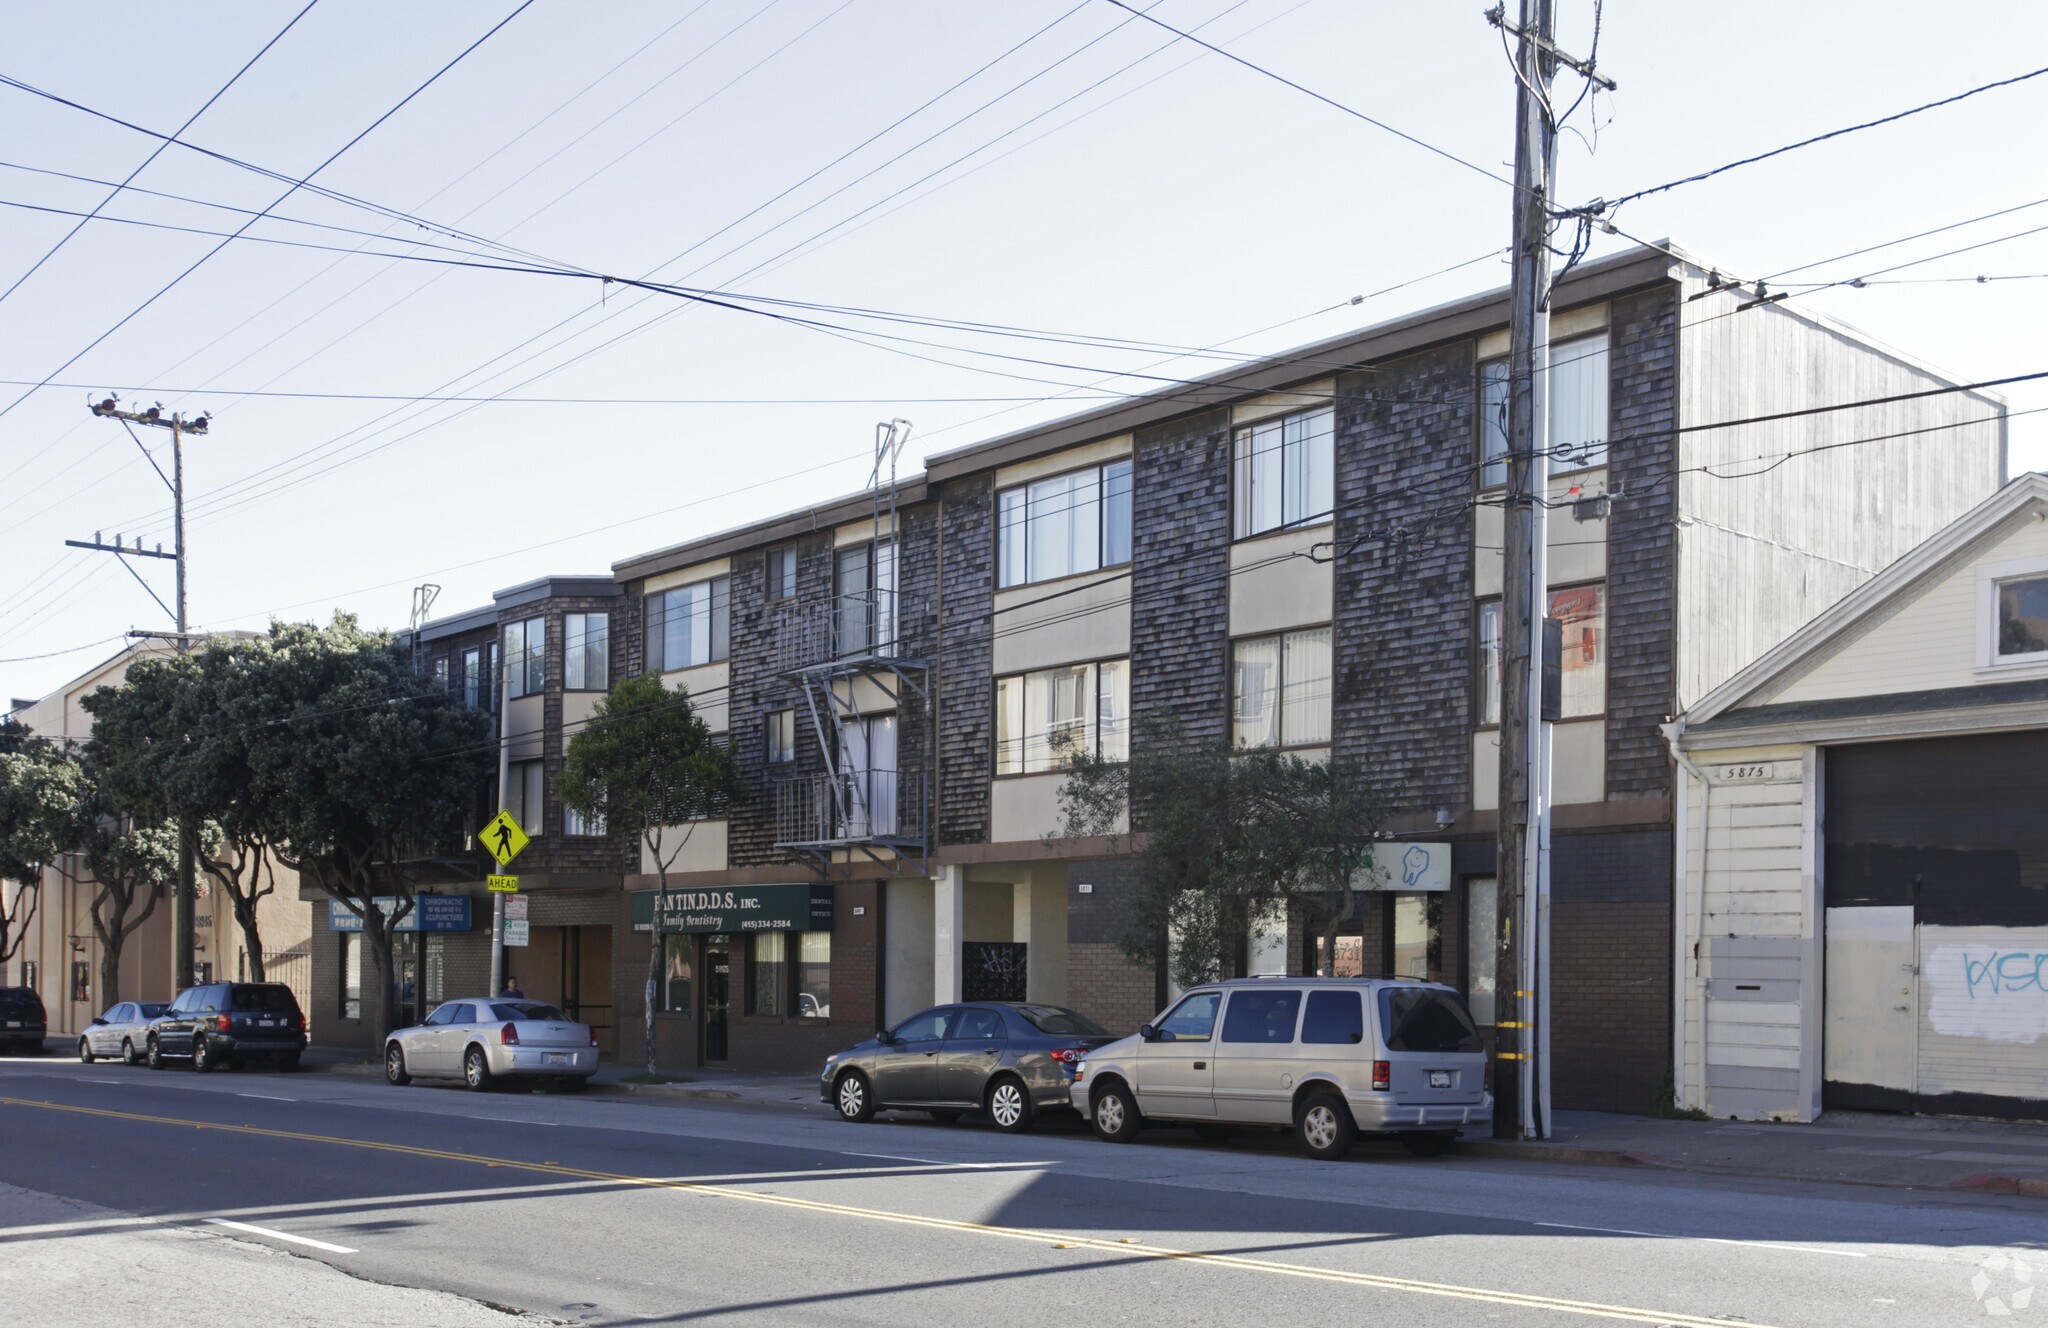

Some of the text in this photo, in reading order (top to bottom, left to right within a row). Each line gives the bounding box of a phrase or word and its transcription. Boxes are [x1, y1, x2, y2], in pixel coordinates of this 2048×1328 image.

[1727, 766, 1764, 779] 5875
[488, 878, 517, 889] AHEAD
[424, 898, 463, 906] CHIROPRACTIC
[740, 898, 761, 909] INC.
[425, 913, 464, 921] ACUPUNCTURE
[662, 913, 684, 931] Family
[686, 914, 723, 931] Dentistry
[504, 920, 511, 929] 2
